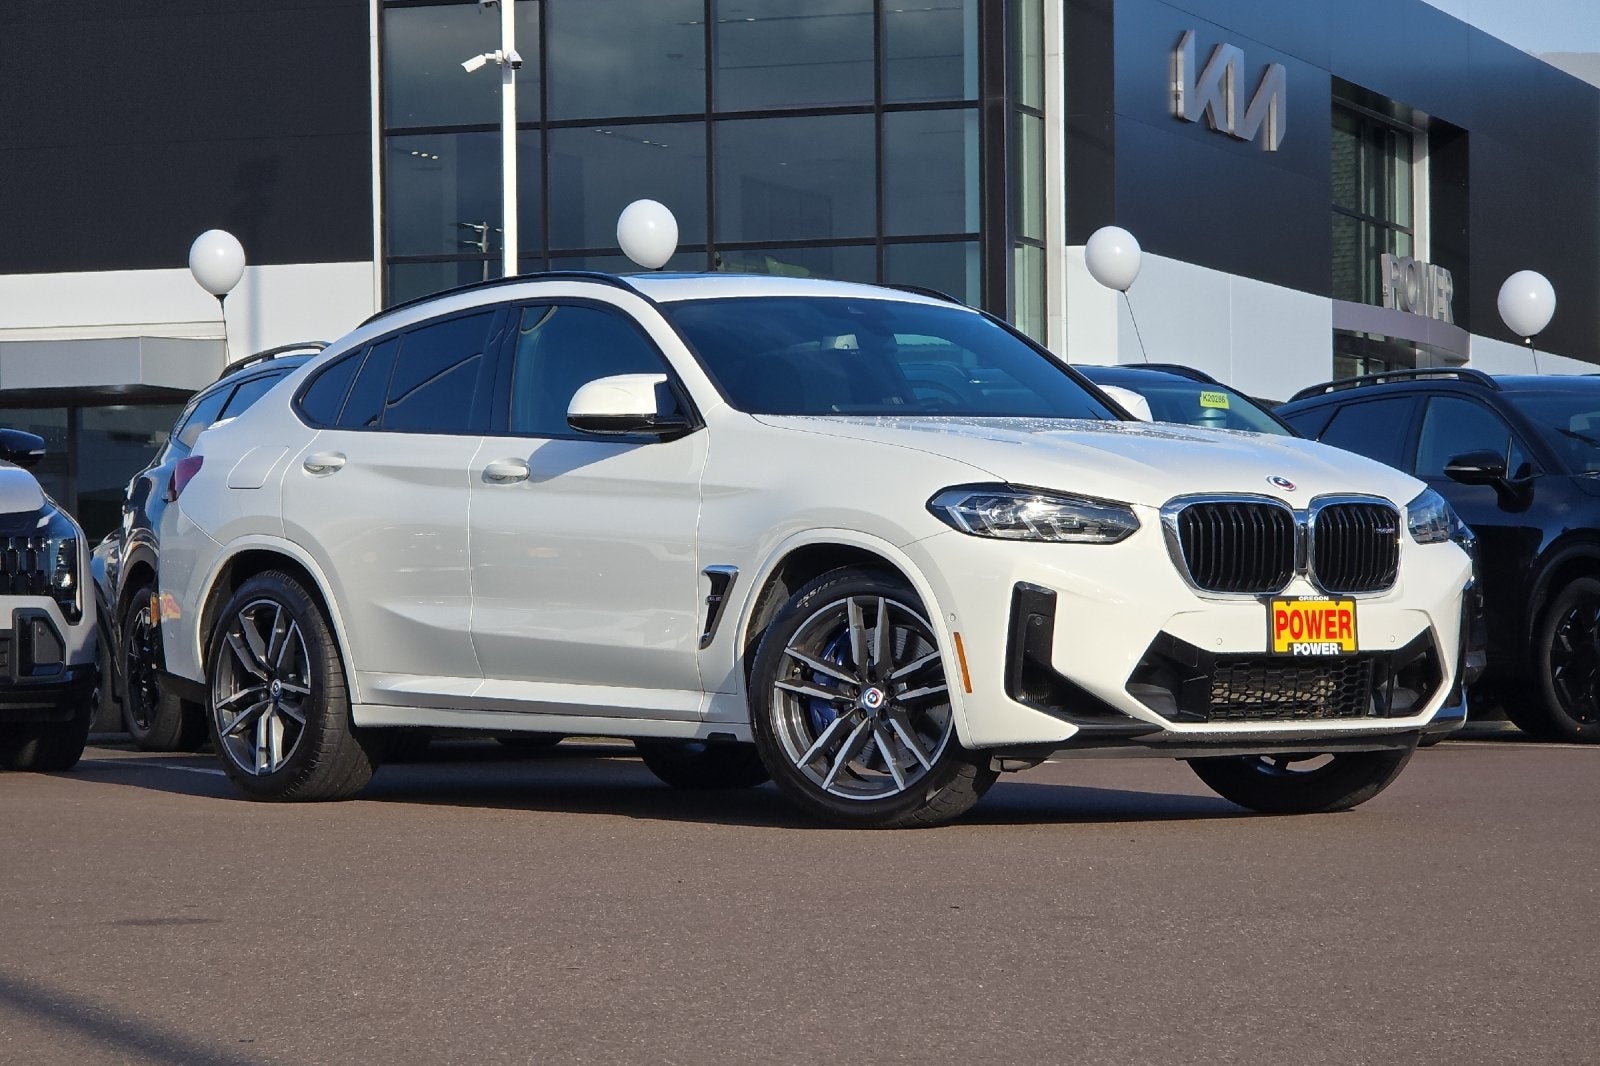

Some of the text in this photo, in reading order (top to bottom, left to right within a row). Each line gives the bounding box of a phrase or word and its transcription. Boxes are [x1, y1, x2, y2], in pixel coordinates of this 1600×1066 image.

[1381, 253, 1454, 324] POWER
[1275, 609, 1352, 640] POWER
[1293, 643, 1339, 656] POWER
